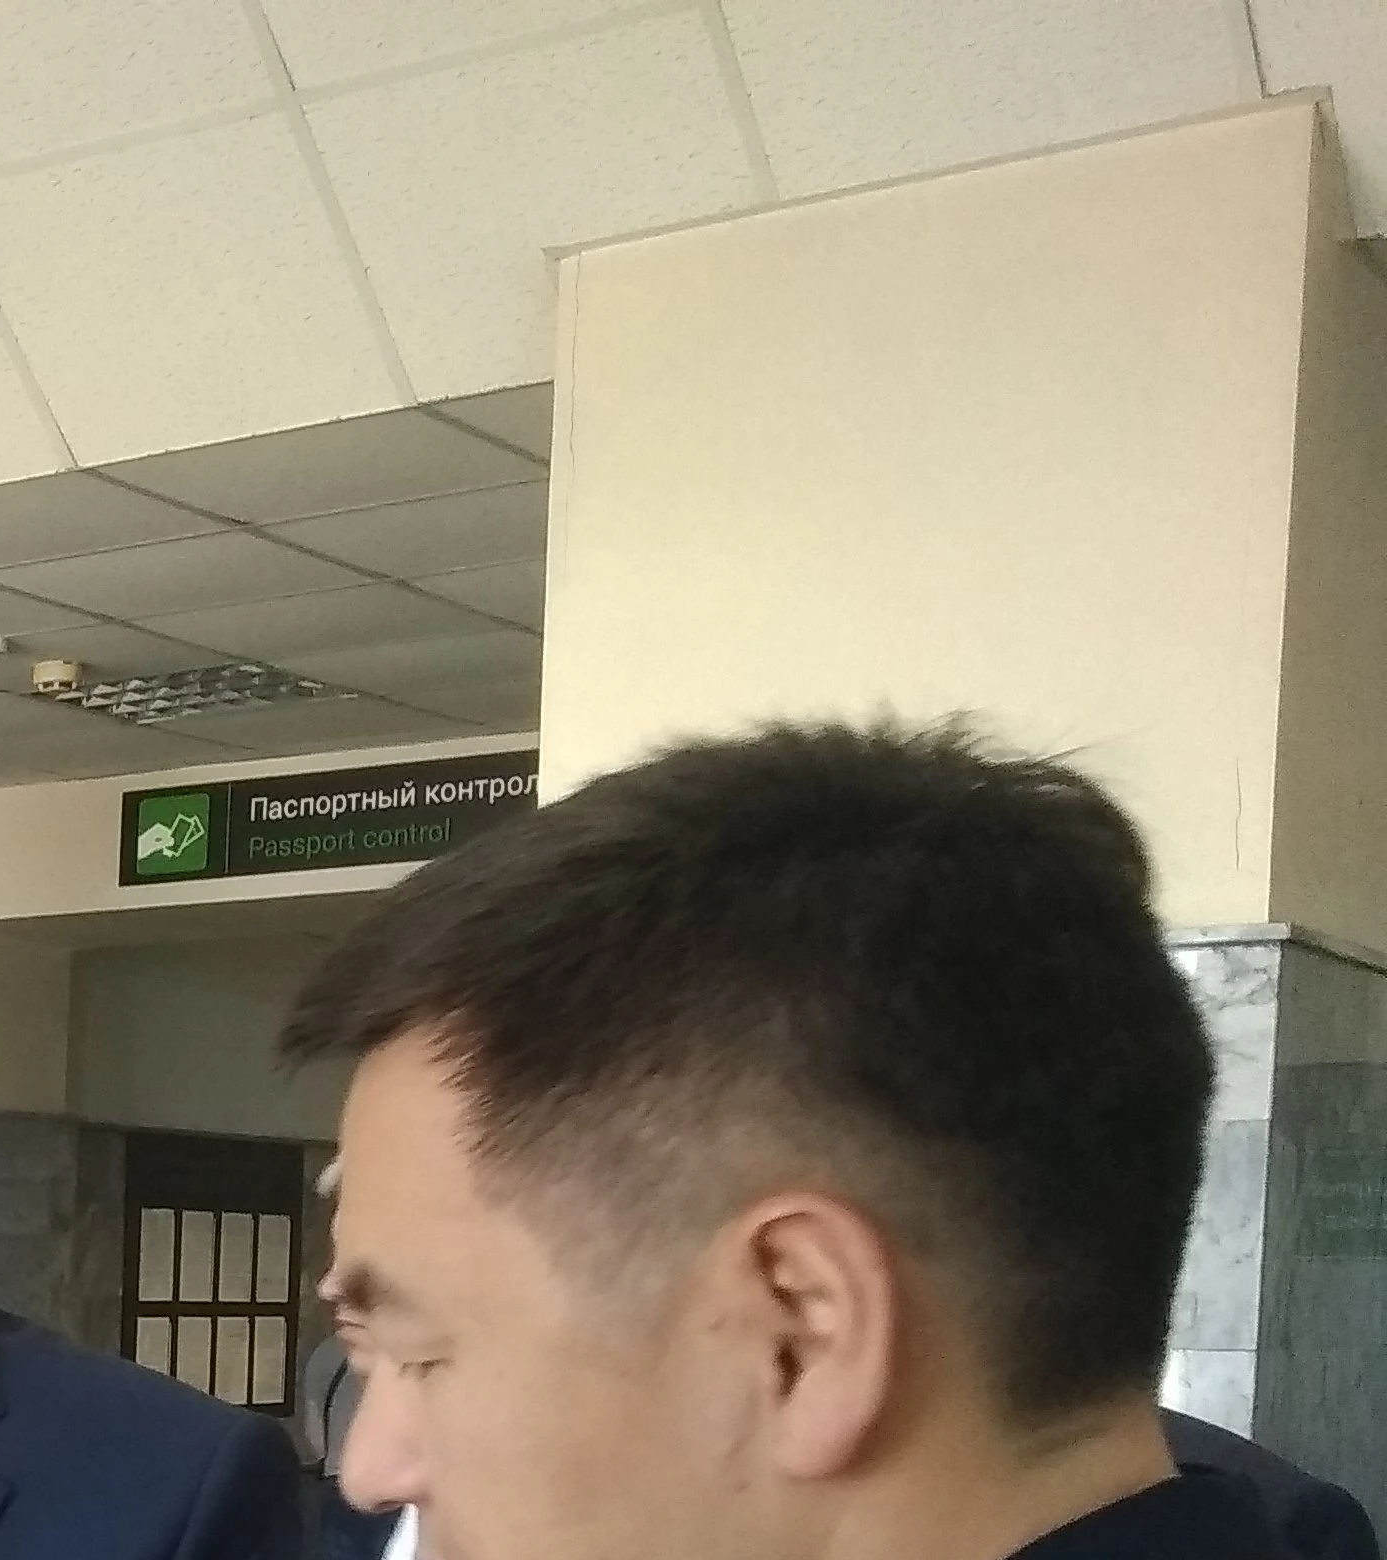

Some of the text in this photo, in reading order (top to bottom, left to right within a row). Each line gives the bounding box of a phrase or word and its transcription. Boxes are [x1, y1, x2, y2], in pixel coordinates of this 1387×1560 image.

[249, 774, 539, 821] Паспортный контрол
[248, 817, 452, 859] Passport control
